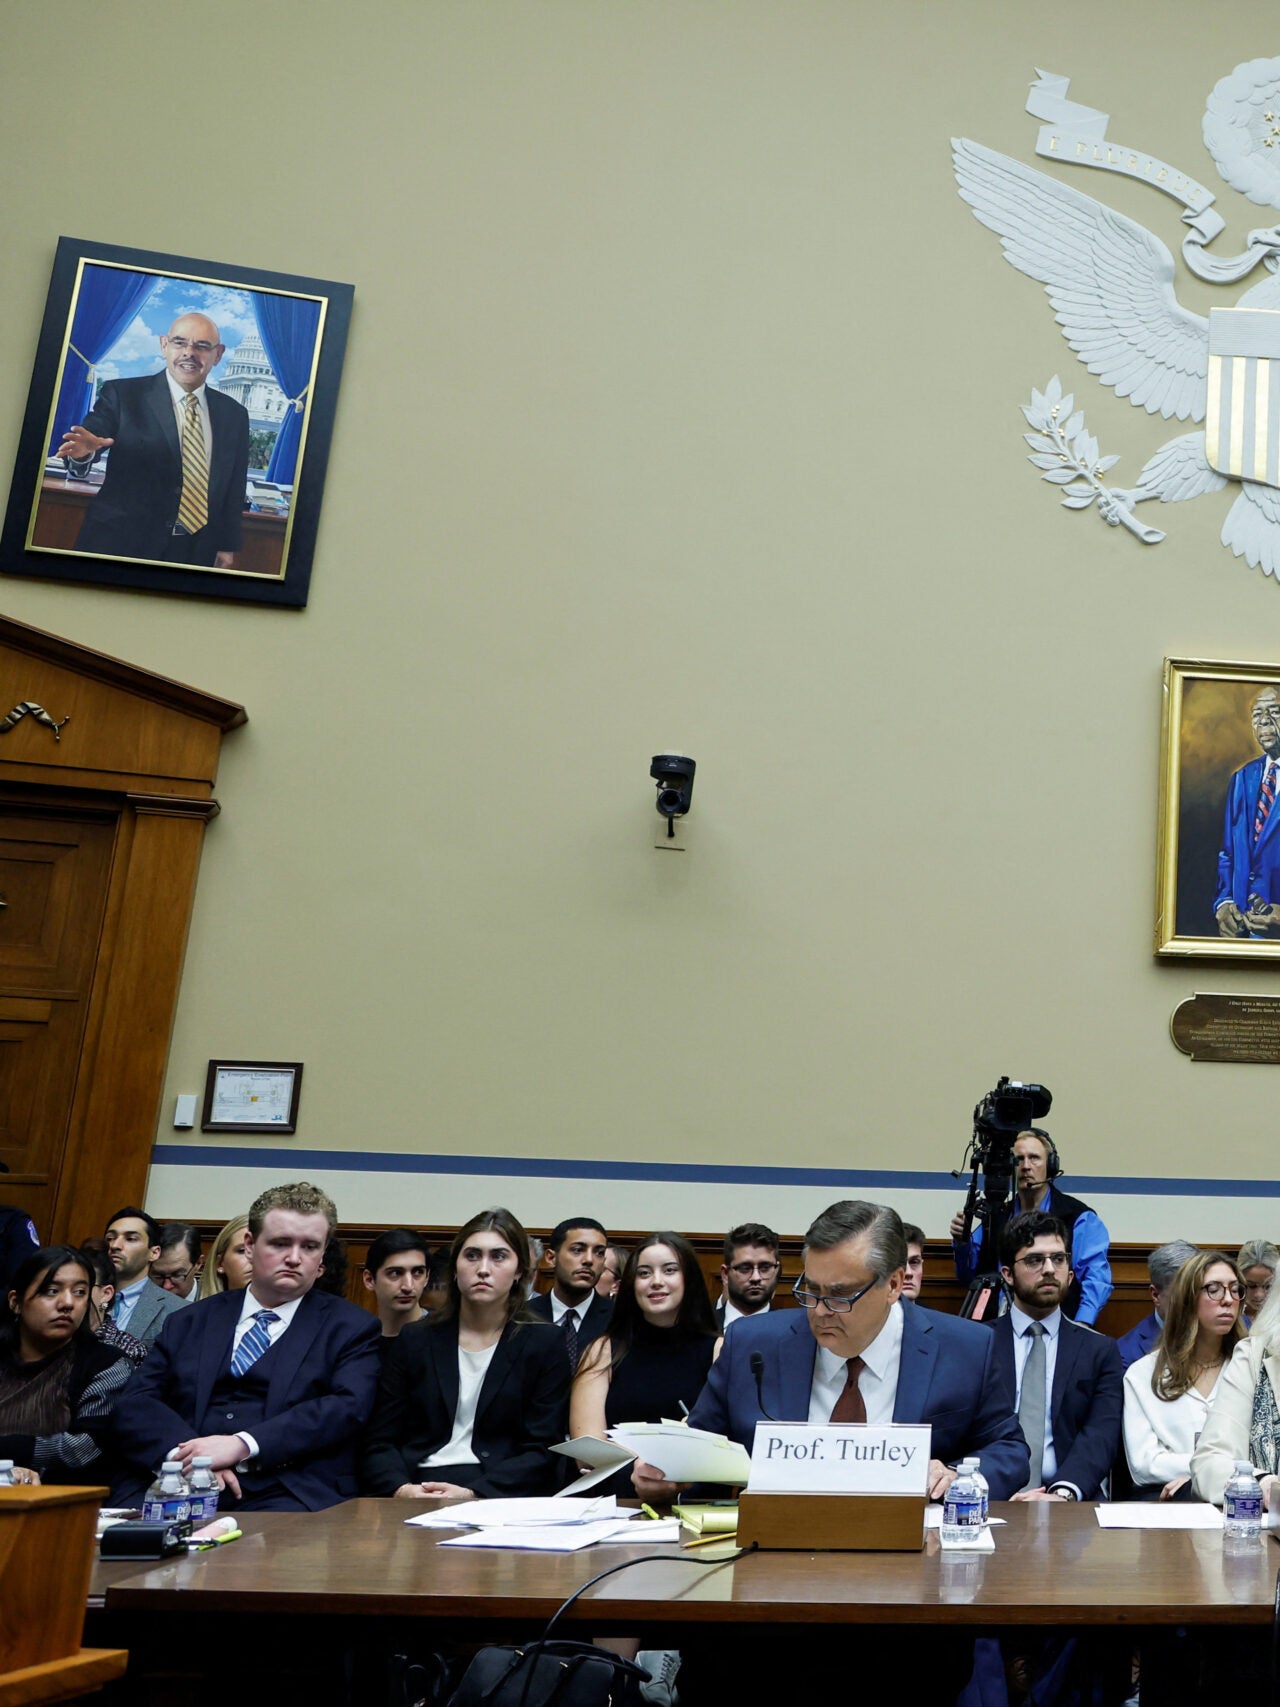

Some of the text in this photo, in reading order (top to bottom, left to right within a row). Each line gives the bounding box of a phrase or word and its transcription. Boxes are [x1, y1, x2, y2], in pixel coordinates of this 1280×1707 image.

[1048, 135, 1203, 203] E PLURIBUS
[766, 1437, 916, 1467] Prof. Turley
